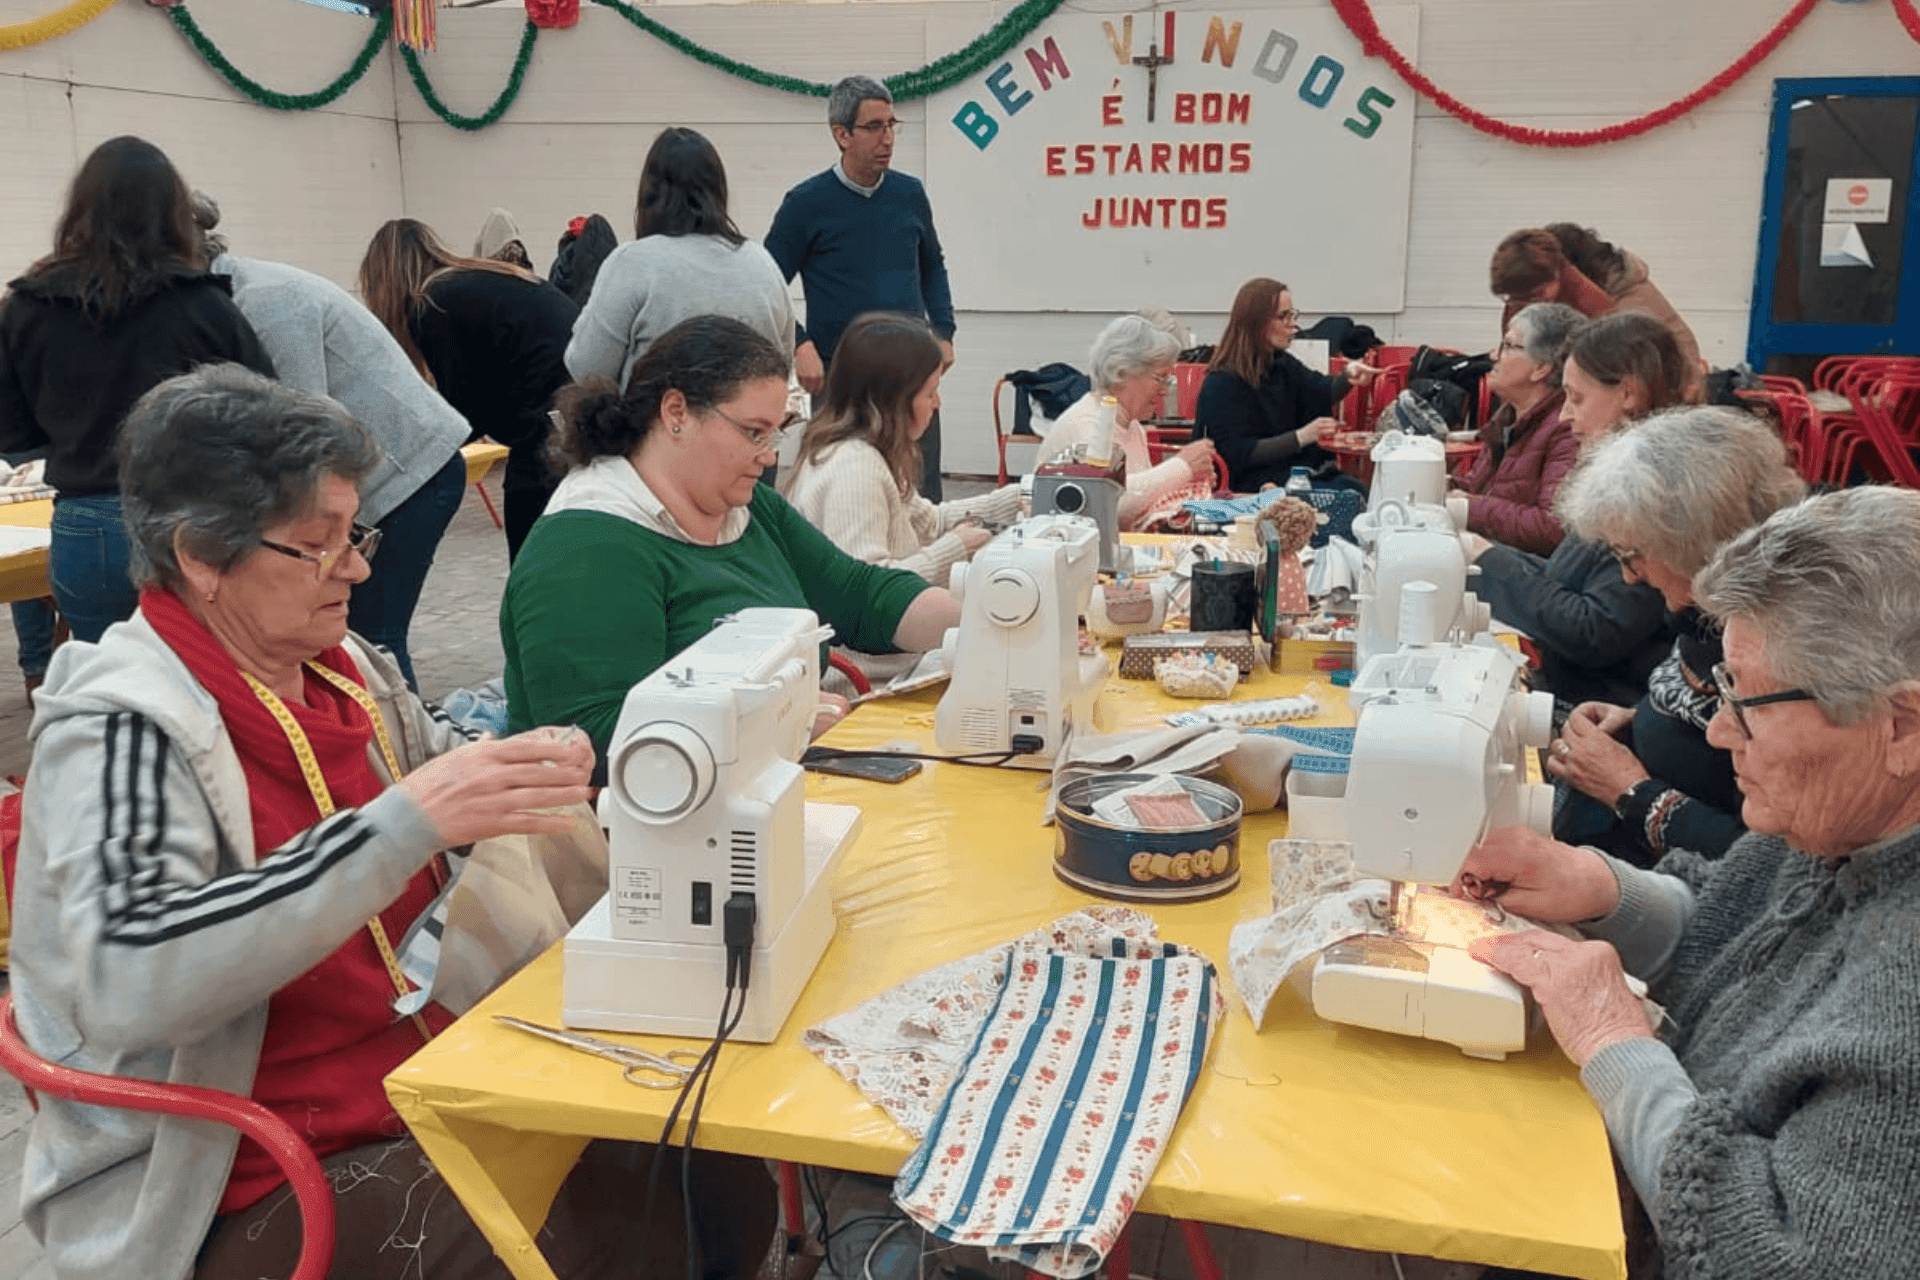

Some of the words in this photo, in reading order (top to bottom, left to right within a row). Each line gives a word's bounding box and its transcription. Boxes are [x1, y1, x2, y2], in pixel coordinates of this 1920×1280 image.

[953, 36, 1071, 151] BEM
[1103, 11, 1395, 139] VINDOS
[1102, 78, 1124, 126] É
[1174, 93, 1252, 124] BOM
[1046, 143, 1252, 177] ESTARMOS
[1082, 197, 1228, 229] JUNTOS
